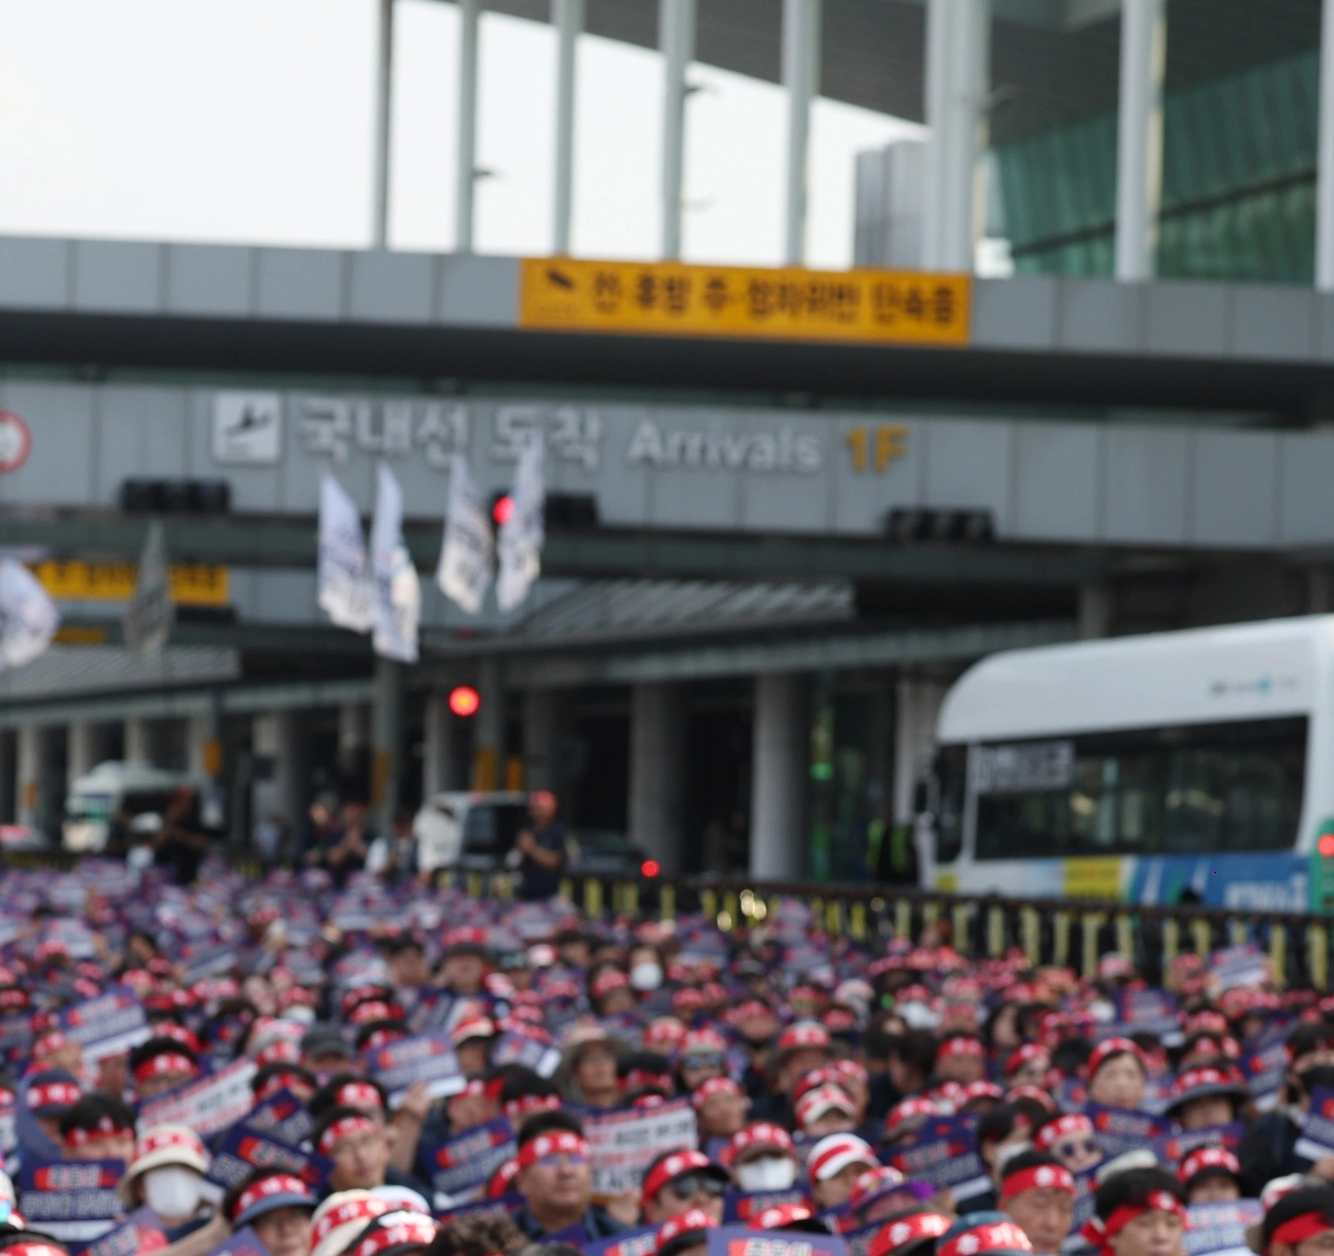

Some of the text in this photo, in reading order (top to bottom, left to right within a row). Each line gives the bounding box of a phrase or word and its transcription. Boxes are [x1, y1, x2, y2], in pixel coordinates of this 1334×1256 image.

[300, 400, 908, 474] 국내선 도착 Arrivals 1F
